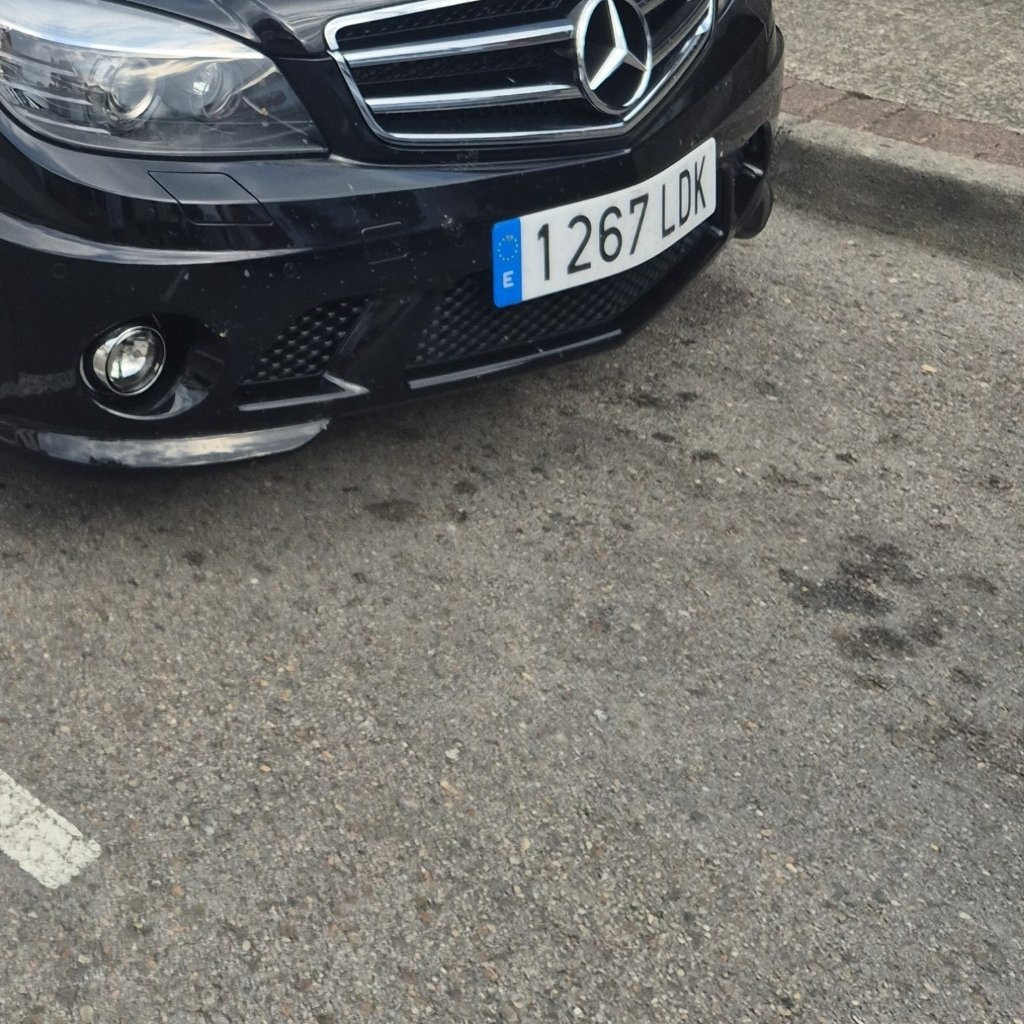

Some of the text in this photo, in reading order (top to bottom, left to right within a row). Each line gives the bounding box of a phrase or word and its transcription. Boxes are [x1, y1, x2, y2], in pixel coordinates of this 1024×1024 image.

[537, 155, 706, 281] 1267 LDK
[502, 270, 514, 288] E
